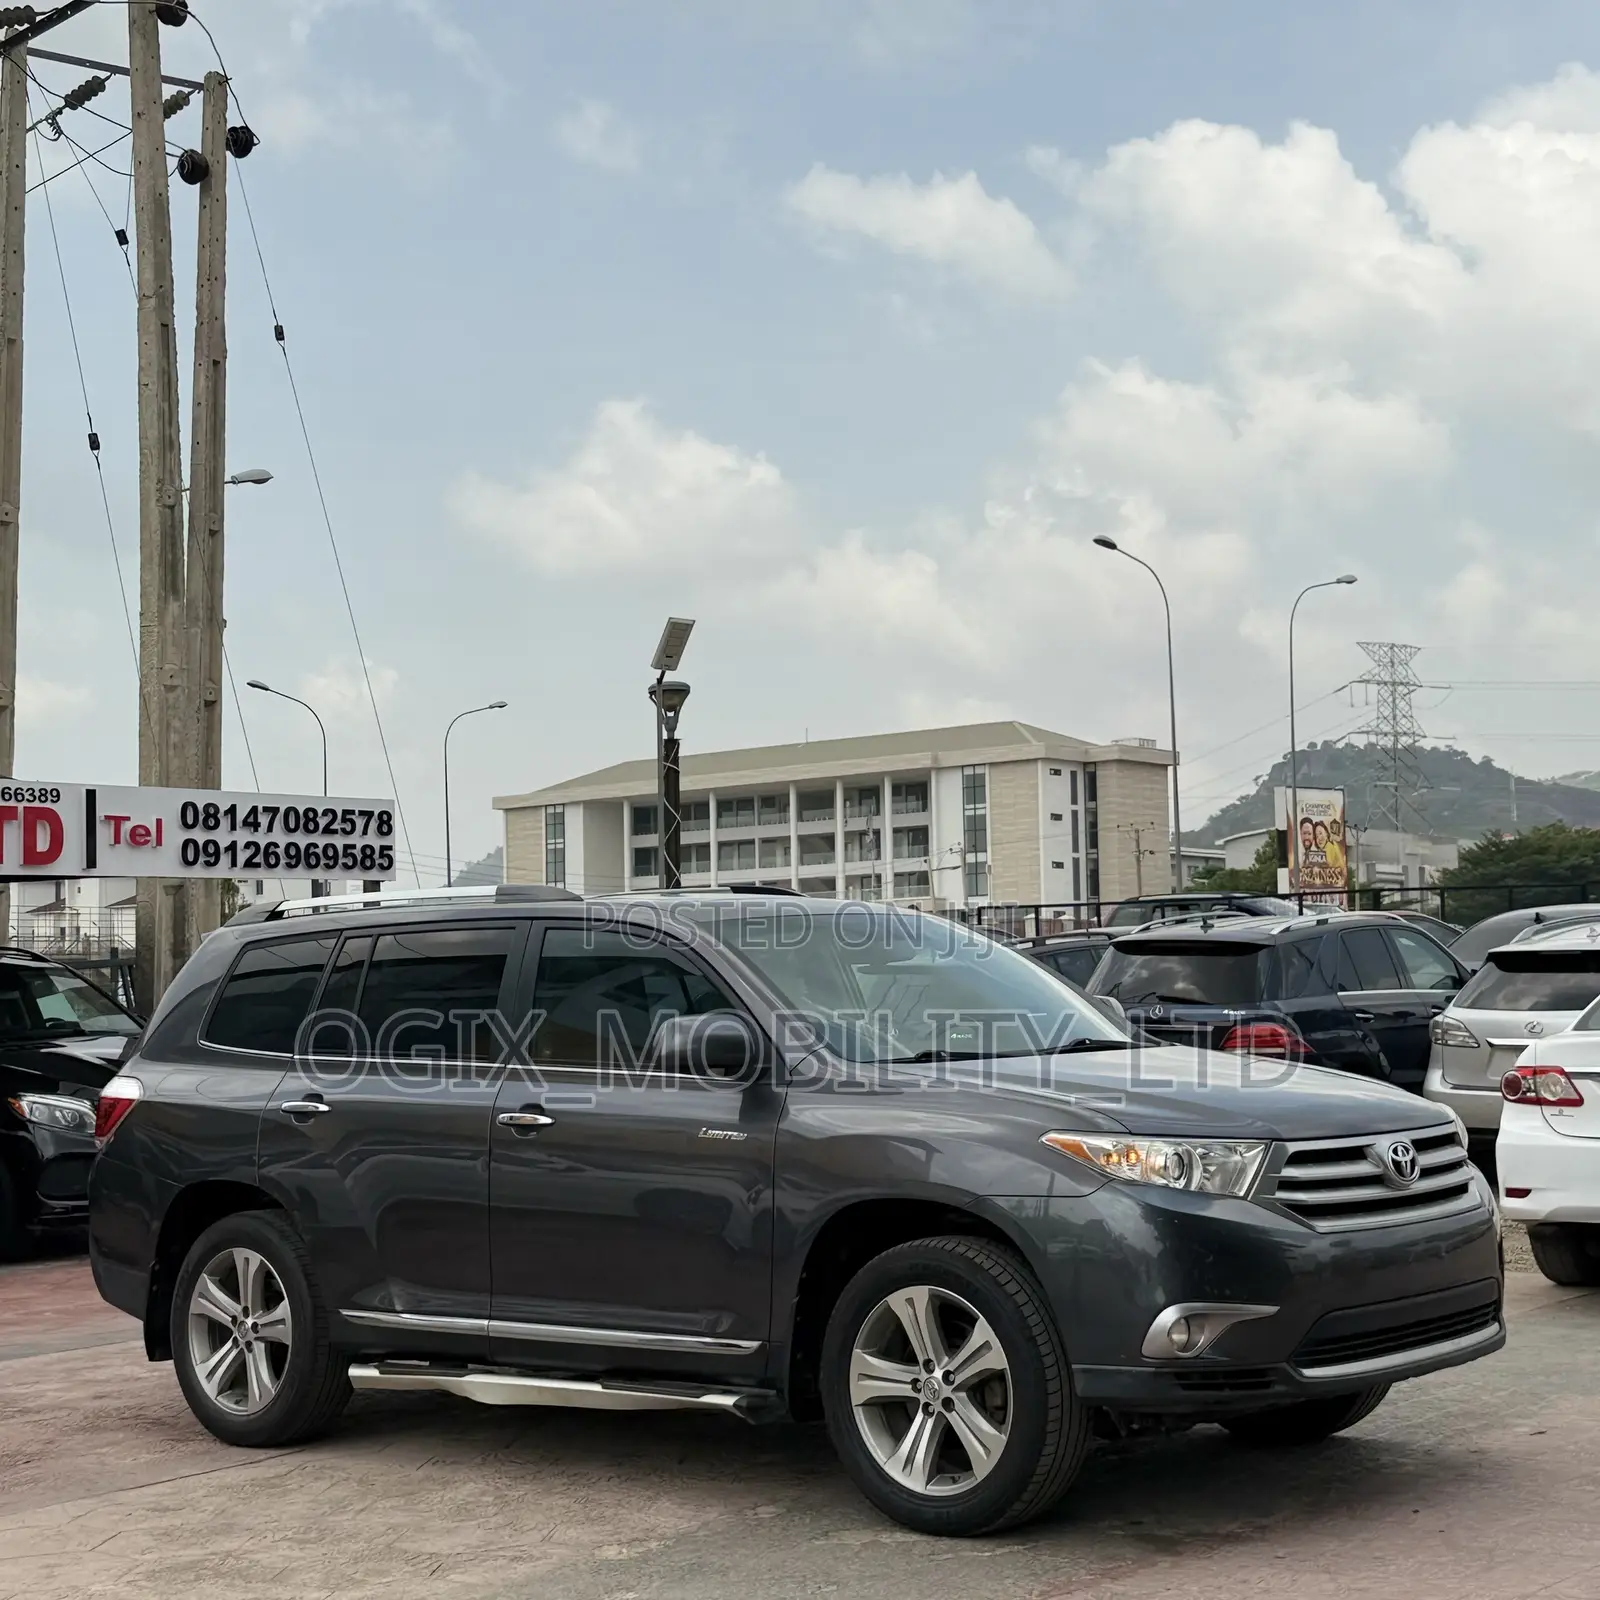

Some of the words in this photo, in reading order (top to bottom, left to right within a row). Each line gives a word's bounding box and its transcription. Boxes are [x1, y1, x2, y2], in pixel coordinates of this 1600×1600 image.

[1, 786, 61, 804] 66389
[103, 814, 163, 847] Tel
[180, 801, 393, 837] 08147082578
[180, 838, 394, 871] 09126969585
